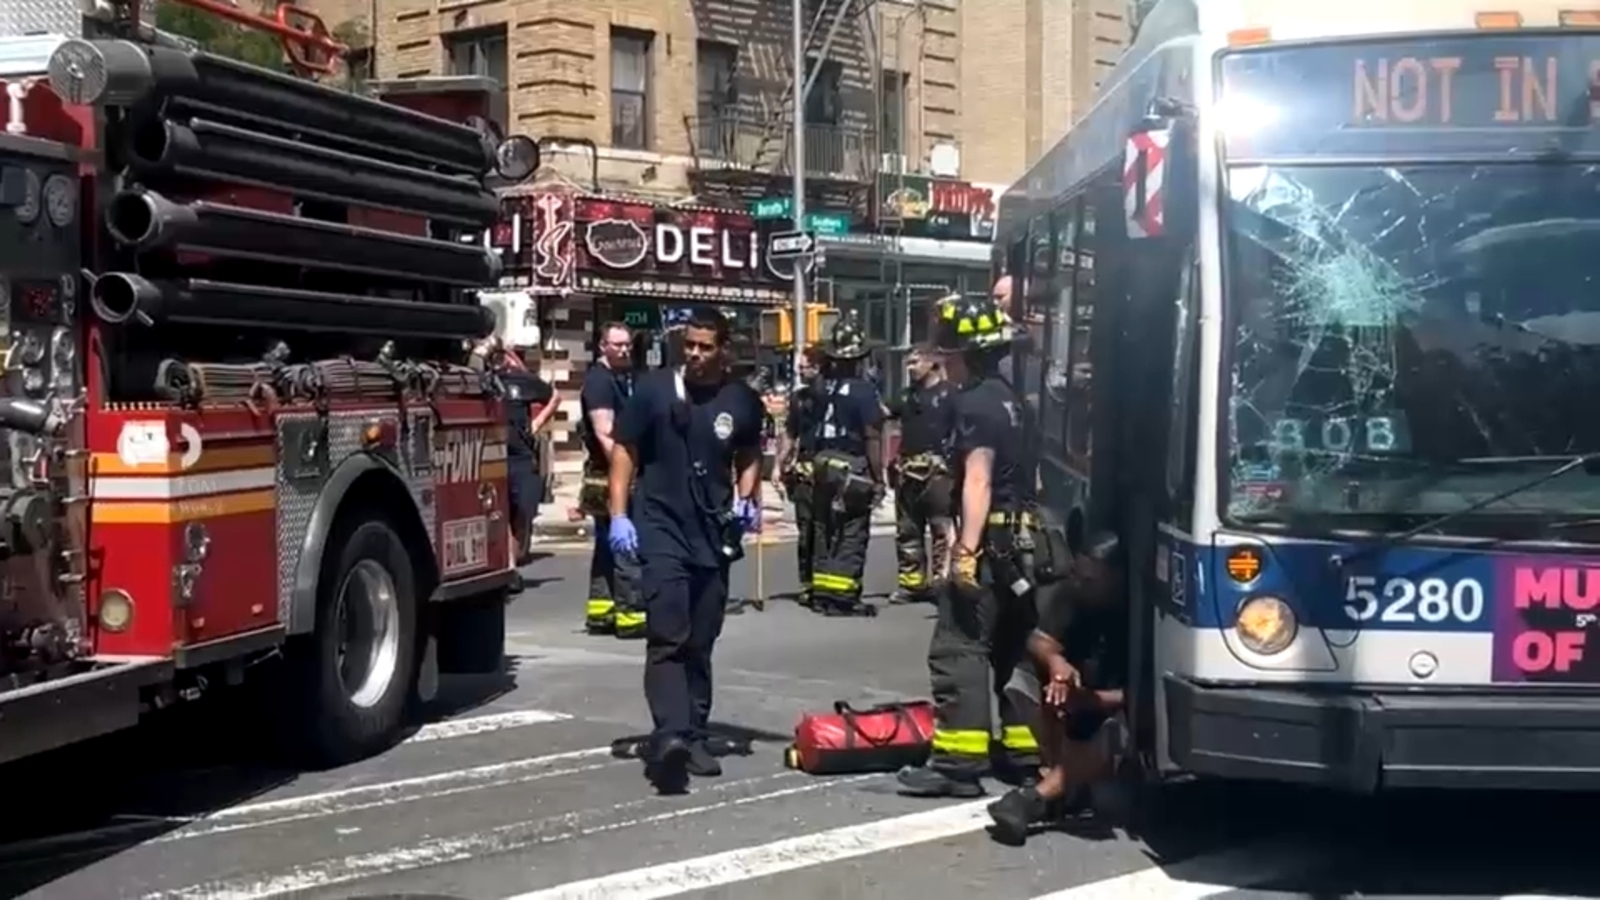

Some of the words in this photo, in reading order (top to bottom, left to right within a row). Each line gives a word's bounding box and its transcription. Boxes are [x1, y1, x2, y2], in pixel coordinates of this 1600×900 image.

[1353, 57, 1461, 124] NOT
[1493, 57, 1557, 122] IN
[656, 223, 758, 269] DELI
[440, 428, 485, 484] FDNY
[1344, 576, 1484, 623] 5280
[1512, 631, 1586, 673] OF
